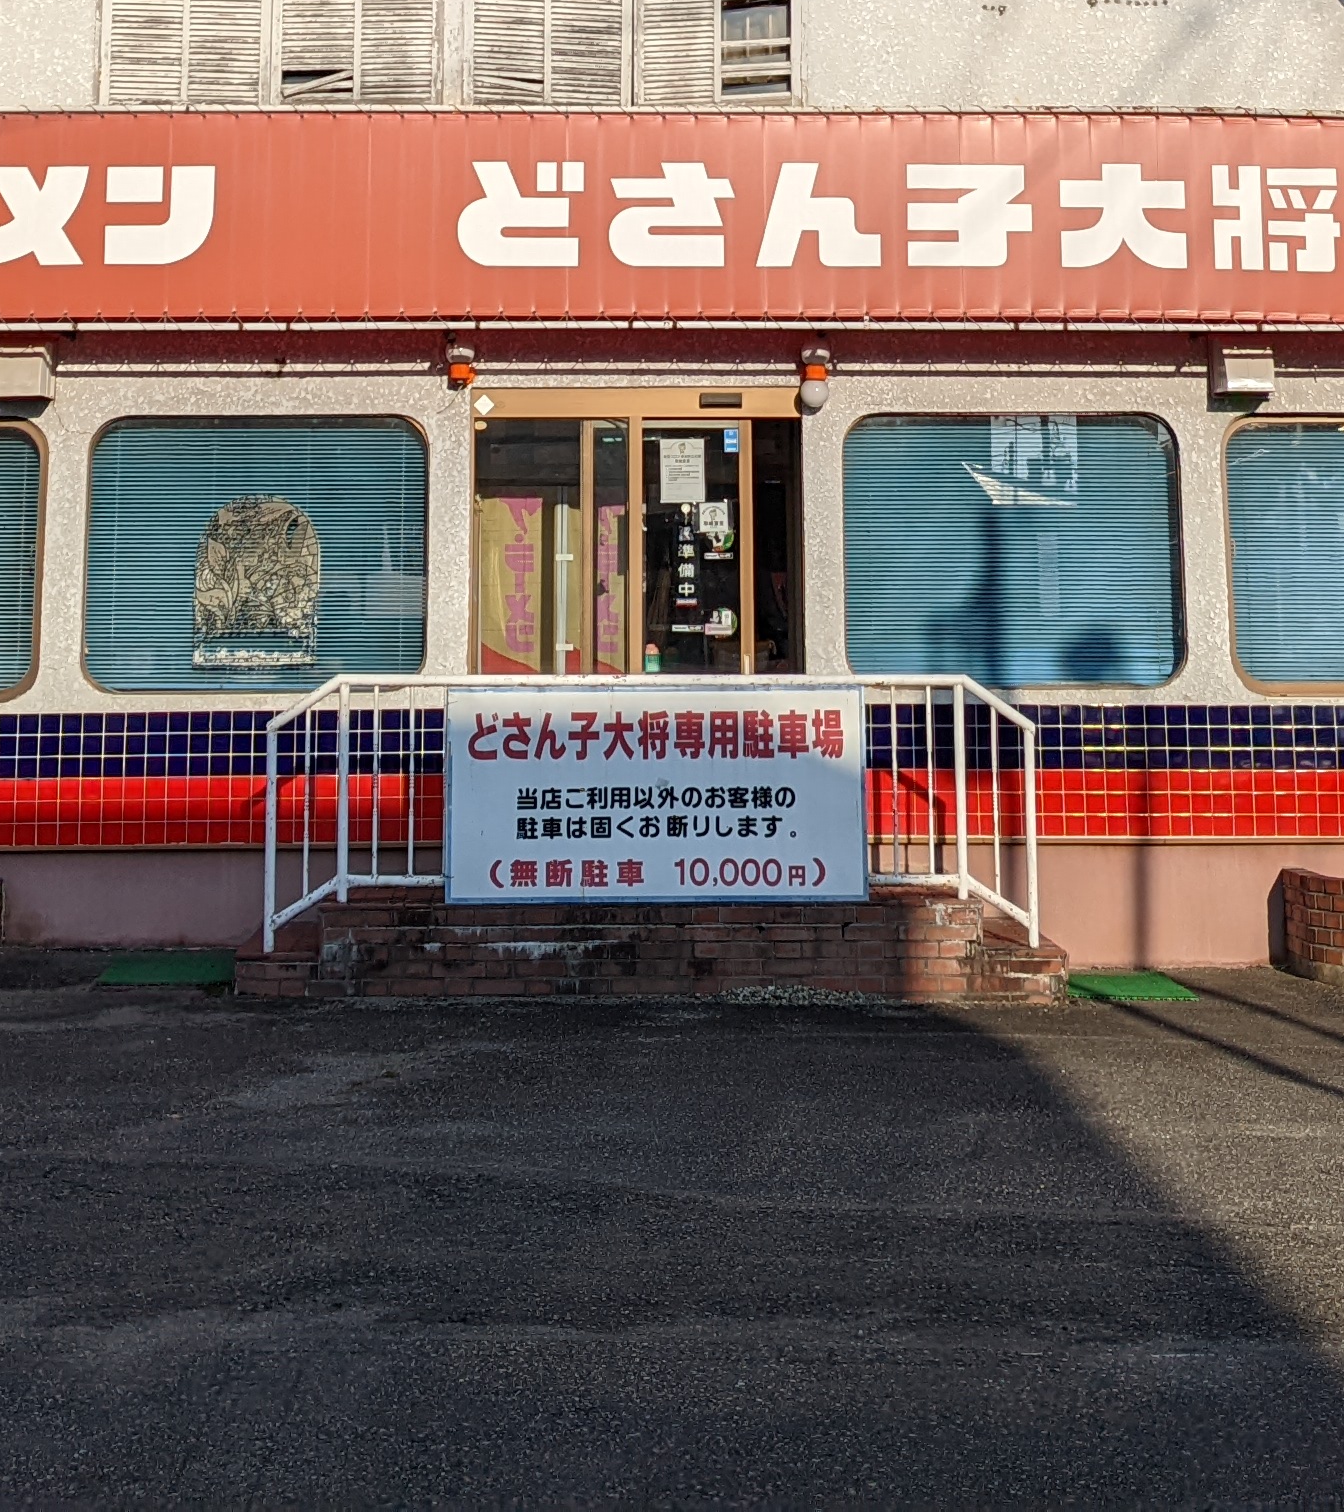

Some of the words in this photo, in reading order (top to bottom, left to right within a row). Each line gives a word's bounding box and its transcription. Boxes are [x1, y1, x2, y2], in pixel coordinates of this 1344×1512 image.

[456, 160, 1342, 273] どさん子大将
[676, 543, 696, 598] 準備中
[466, 709, 845, 761] どさん子大将専用駐車場
[516, 786, 797, 811] 当店ご利用以外のお客様の
[515, 814, 799, 840] 駐車は固くお断りします。
